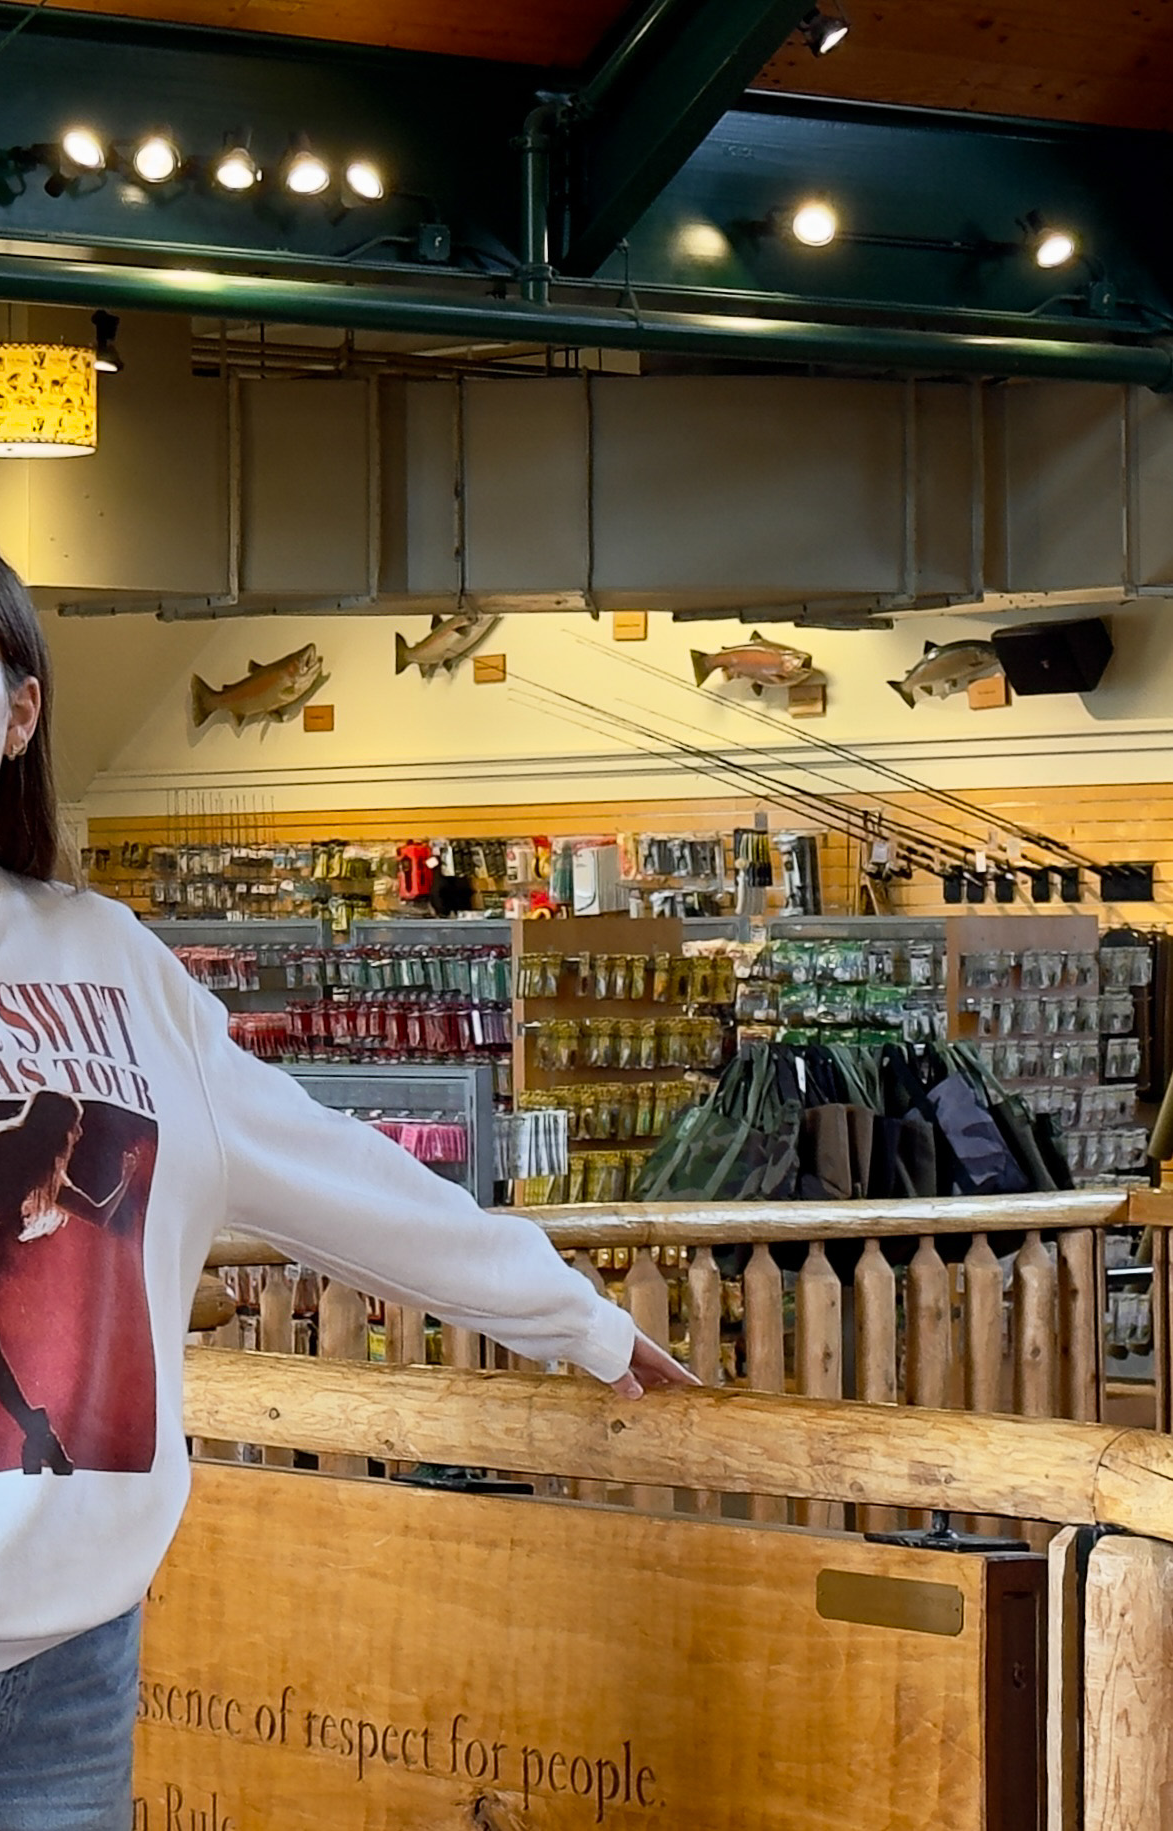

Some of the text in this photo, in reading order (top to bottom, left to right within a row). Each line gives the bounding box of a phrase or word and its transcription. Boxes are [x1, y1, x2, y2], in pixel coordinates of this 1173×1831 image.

[54, 1058, 156, 1114] TOUR
[255, 1686, 296, 1744] of
[306, 1711, 434, 1782] respect
[451, 1713, 508, 1781] for
[522, 1739, 666, 1824] people.
